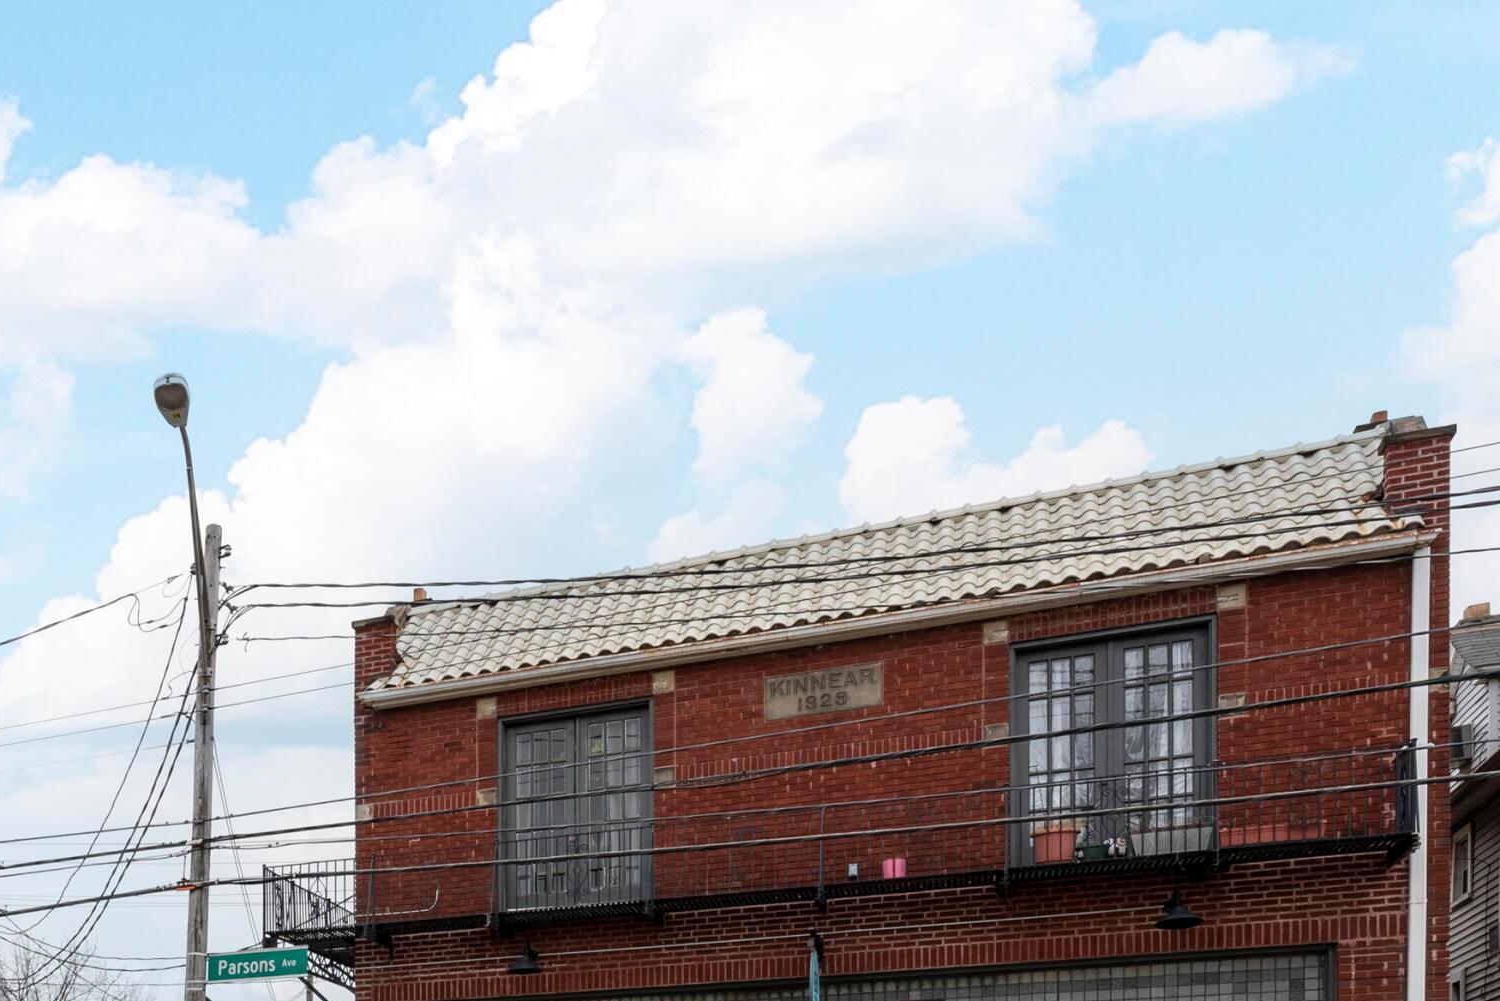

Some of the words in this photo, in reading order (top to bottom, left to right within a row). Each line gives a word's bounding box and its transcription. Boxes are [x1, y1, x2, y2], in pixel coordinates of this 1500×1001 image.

[770, 668, 877, 697] KINNEAR
[218, 959, 275, 976] Parsons
[282, 958, 297, 967] Ave
